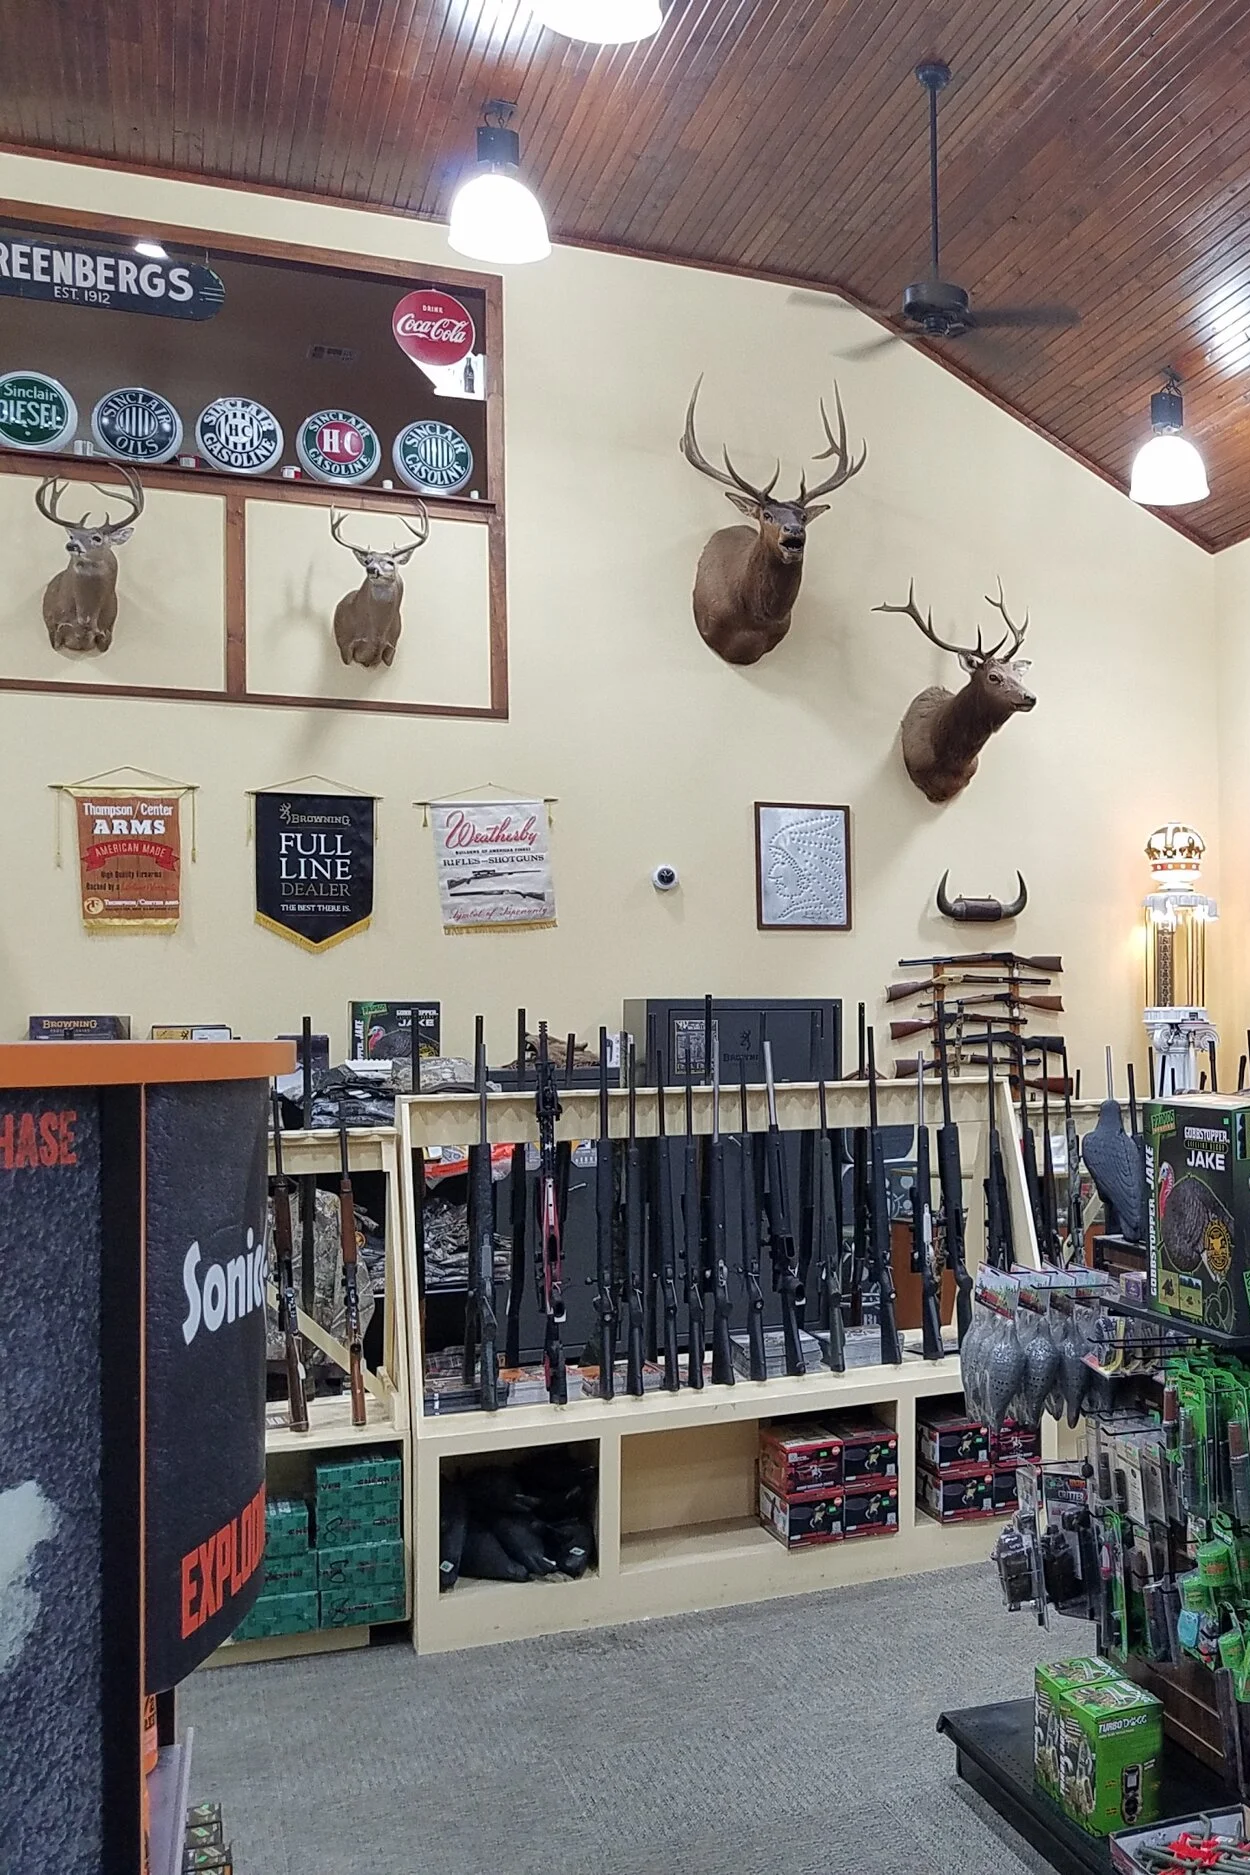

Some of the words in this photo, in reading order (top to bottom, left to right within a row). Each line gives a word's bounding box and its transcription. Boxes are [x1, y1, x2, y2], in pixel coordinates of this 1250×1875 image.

[54, 287, 79, 300] EST.
[84, 290, 111, 304] 1912
[422, 304, 444, 314] DRINK
[396, 313, 469, 343] Coca-Cola
[4, 383, 57, 401] Sinclair
[103, 393, 171, 425] SINCLAIR
[203, 399, 275, 431] SINCLAIR
[309, 412, 371, 439] SINCLAIR
[116, 436, 158, 458] OILS
[204, 432, 276, 467] GASOLINE
[405, 425, 466, 454] SINCLAIR
[309, 447, 372, 475] GASOLINE
[405, 453, 467, 486] GASOLINE
[93, 819, 166, 835] ARMS
[291, 814, 350, 825] BROWNING
[445, 810, 538, 849] Weatherby
[95, 842, 139, 857] AMERICAN
[142, 843, 166, 857] MADE
[279, 833, 352, 856] FULL
[279, 858, 352, 880] LINE
[443, 858, 480, 866] RIFLES
[488, 855, 544, 865] SHOTGUNS
[281, 883, 351, 897] DEALER
[280, 904, 296, 912] THE
[298, 904, 315, 912] BEST
[317, 904, 341, 912] THERE
[43, 1019, 98, 1029] BROWNING
[1152, 1111, 1175, 1127] PRIMOS
[1184, 1126, 1227, 1143] GOBBSTOPPER
[1145, 1144, 1155, 1190] JAKE
[1186, 1150, 1226, 1171] JAKE
[1149, 1190, 1158, 1296] GOBBSTOPPER
[1099, 1719, 1123, 1734] TURBO
